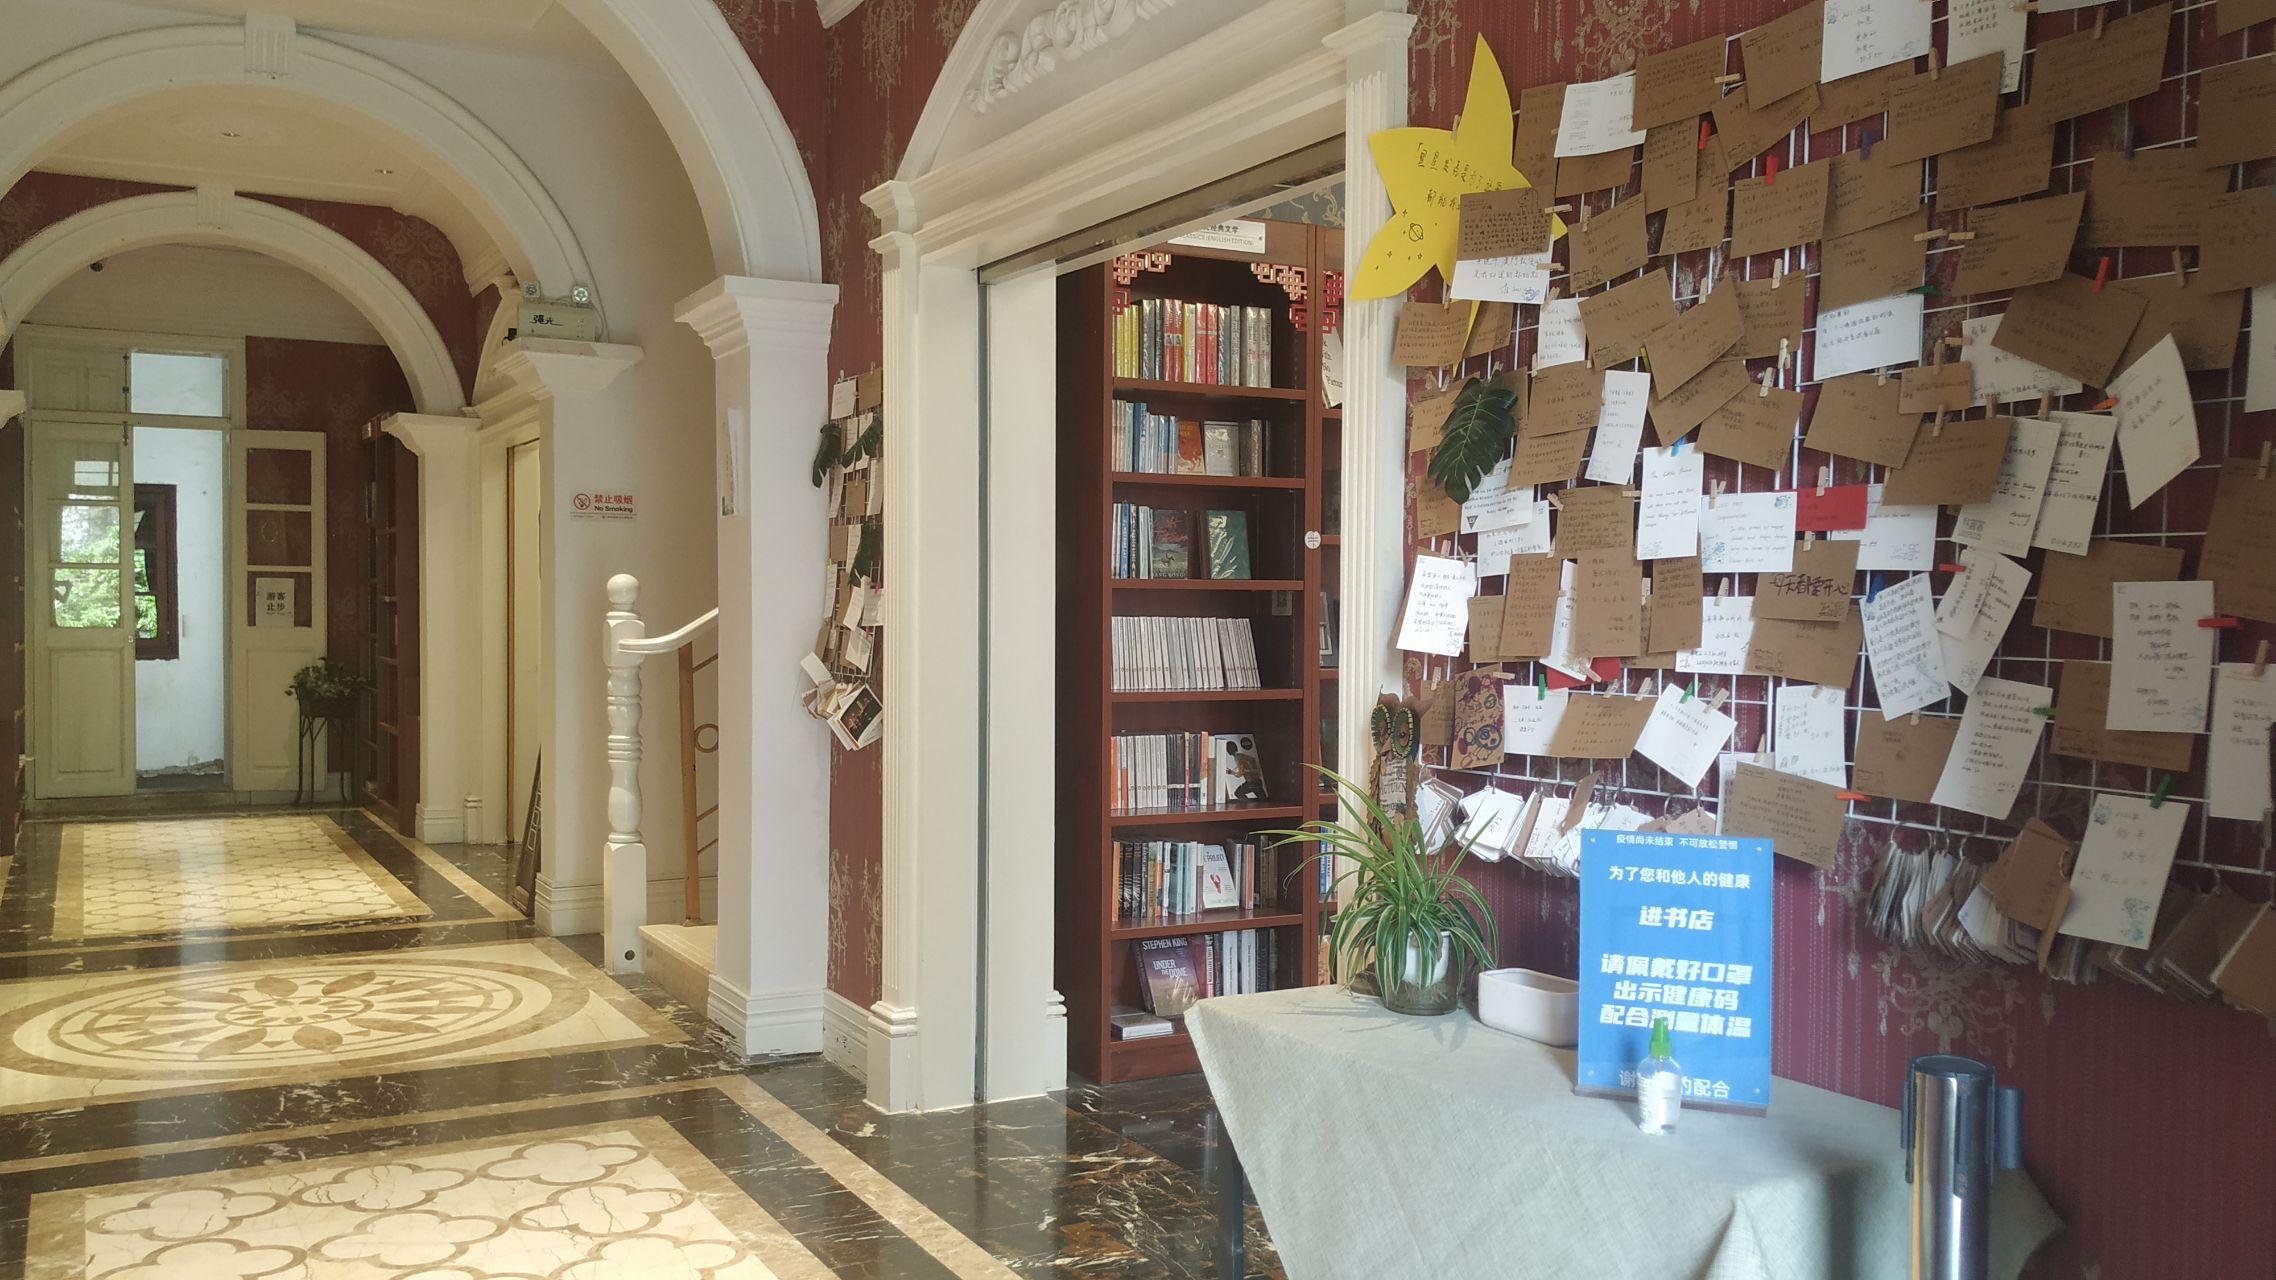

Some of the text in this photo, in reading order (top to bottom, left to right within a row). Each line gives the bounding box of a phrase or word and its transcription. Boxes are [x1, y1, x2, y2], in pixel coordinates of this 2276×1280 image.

[1206, 223, 1239, 234] 经典文学
[594, 494, 633, 505] 禁止吸烟
[604, 505, 634, 513] Smoking
[1616, 834, 1739, 850] 疫情尚未结束 不可放松警惕
[1608, 865, 1751, 890] 为了您和他人的健康
[1638, 905, 1715, 932] 进书店
[1142, 937, 1188, 951] STEPHEN KING
[1152, 958, 1177, 970] UNDER
[1600, 953, 1753, 987] 请佩戴好口罩
[1168, 966, 1189, 978] DOME
[1613, 982, 1740, 1011] 出示健康码
[1599, 1004, 1753, 1038] 配合测量体温
